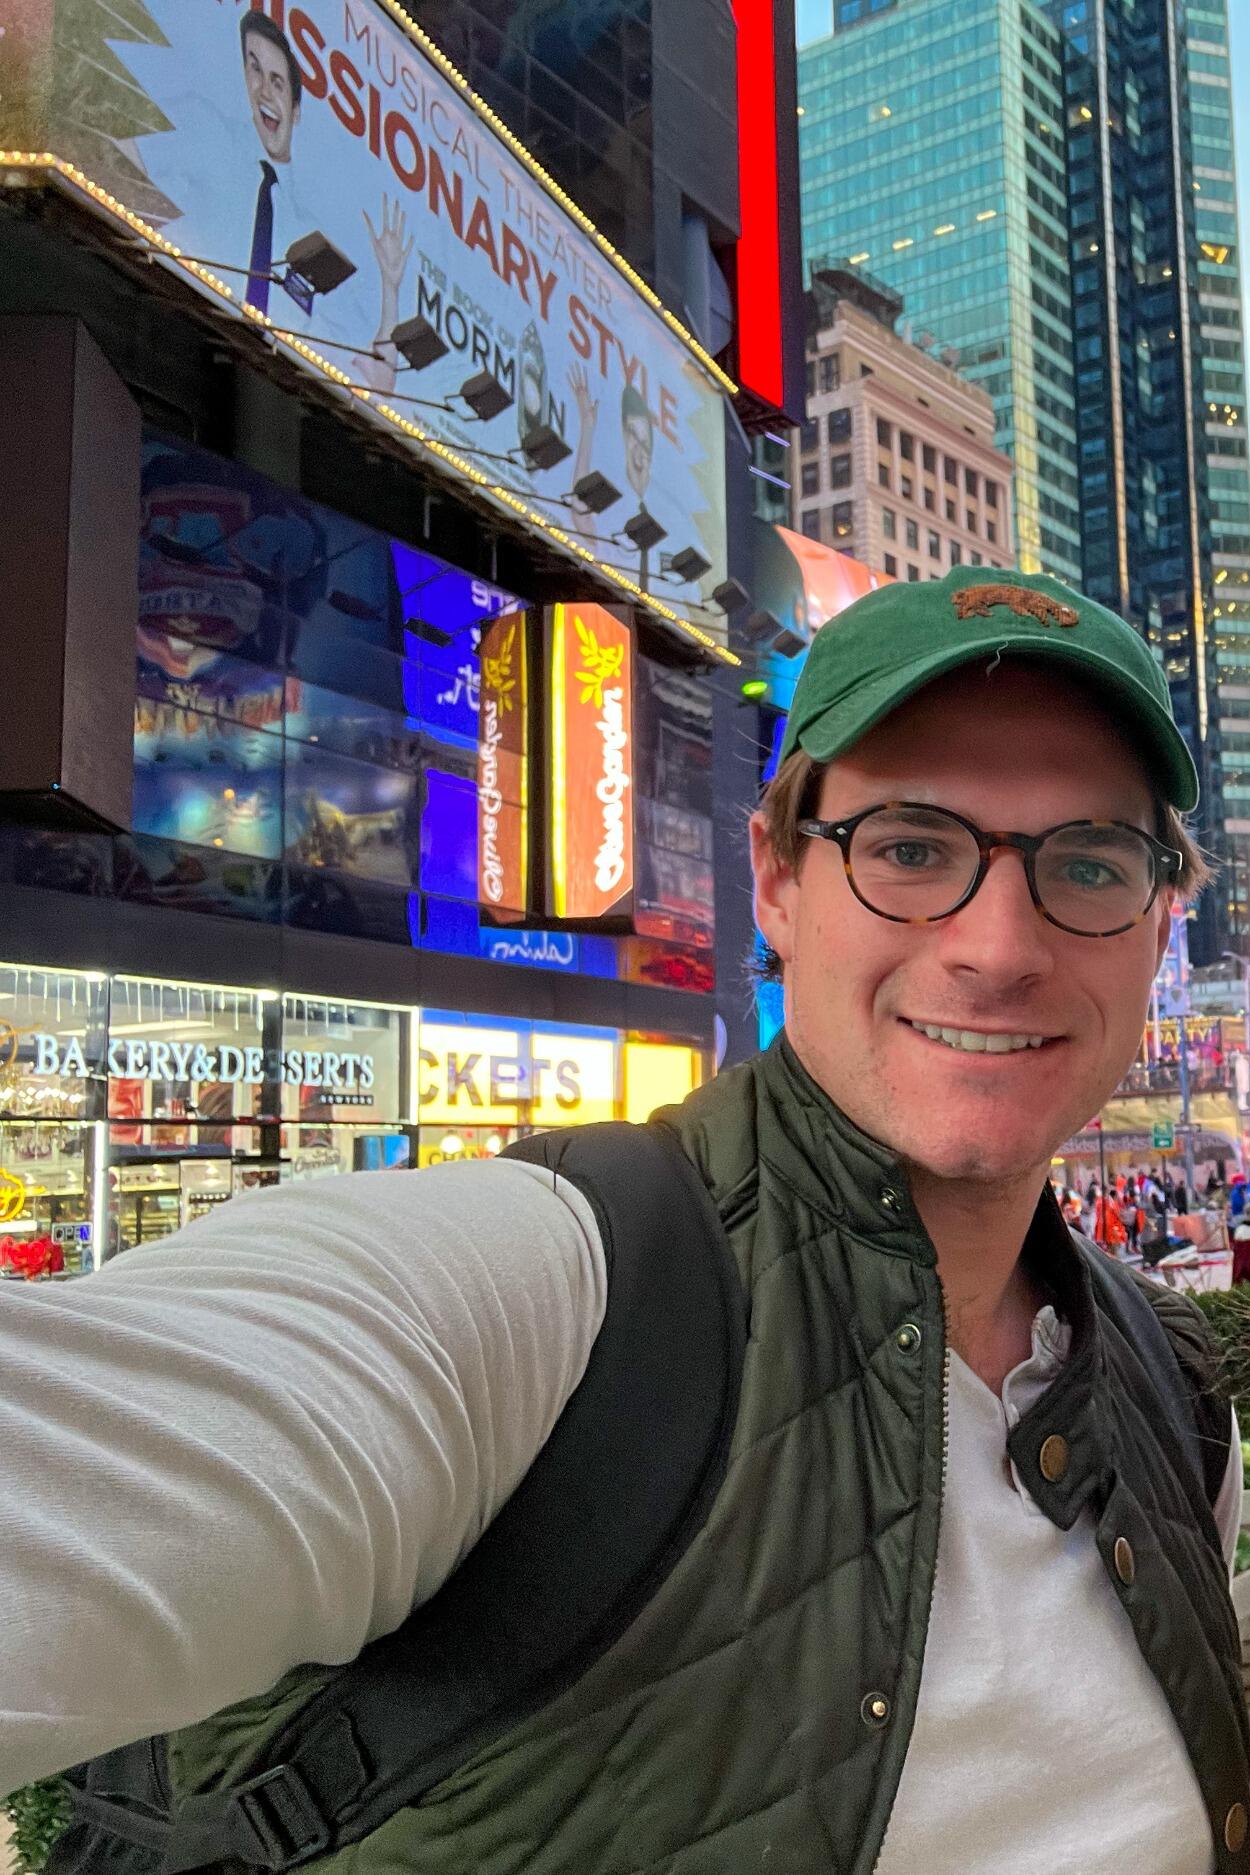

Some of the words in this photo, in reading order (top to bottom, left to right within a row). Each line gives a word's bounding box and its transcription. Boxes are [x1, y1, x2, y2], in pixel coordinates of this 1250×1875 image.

[345, 2, 490, 191] MUSICAL
[497, 176, 616, 323] THEATER
[217, 0, 558, 323] SSIONARY
[568, 294, 684, 452] STYLE
[594, 687, 630, 804] Garden
[594, 800, 625, 892] Olive
[54, 1226, 91, 1241] OPEN
